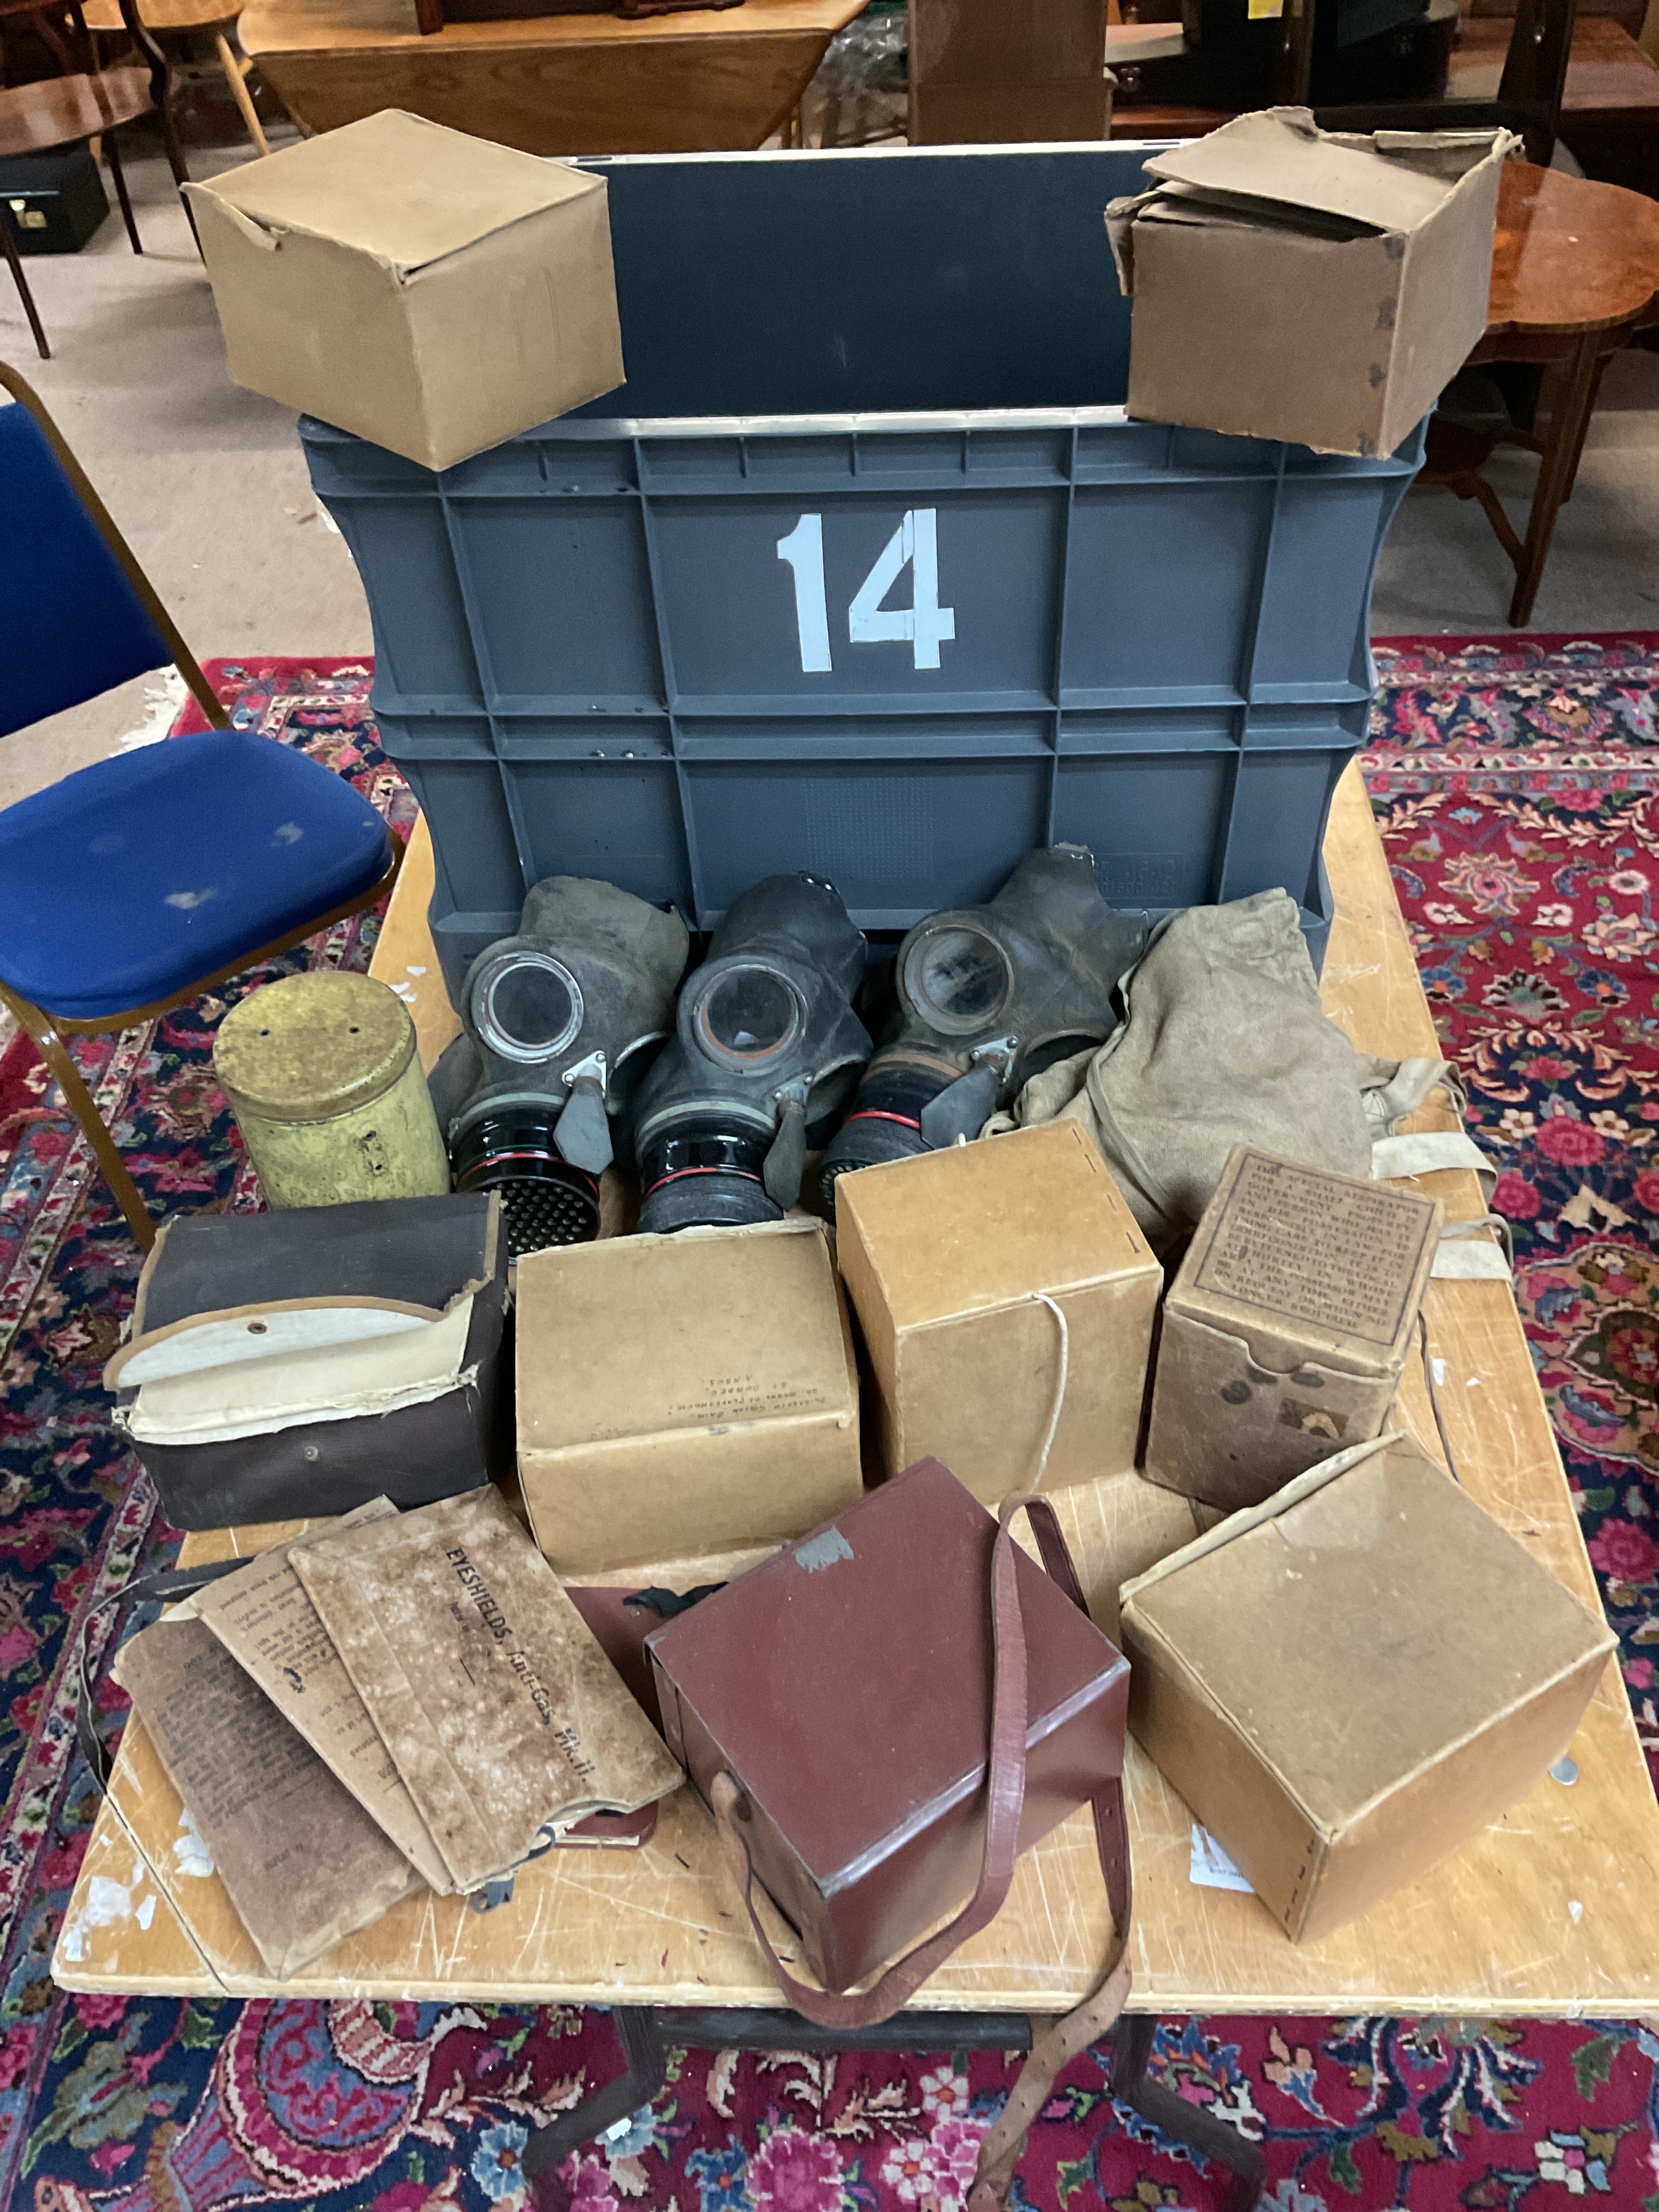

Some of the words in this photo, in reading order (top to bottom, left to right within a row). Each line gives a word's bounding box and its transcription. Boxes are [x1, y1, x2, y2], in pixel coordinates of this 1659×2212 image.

[776, 508, 956, 672] 14
[1250, 1173, 1275, 1185] FOR
[1287, 1175, 1335, 1193] SPECIAL
[1220, 1250, 1253, 1265] ARA
[1225, 1242, 1302, 1270] AUHORITY
